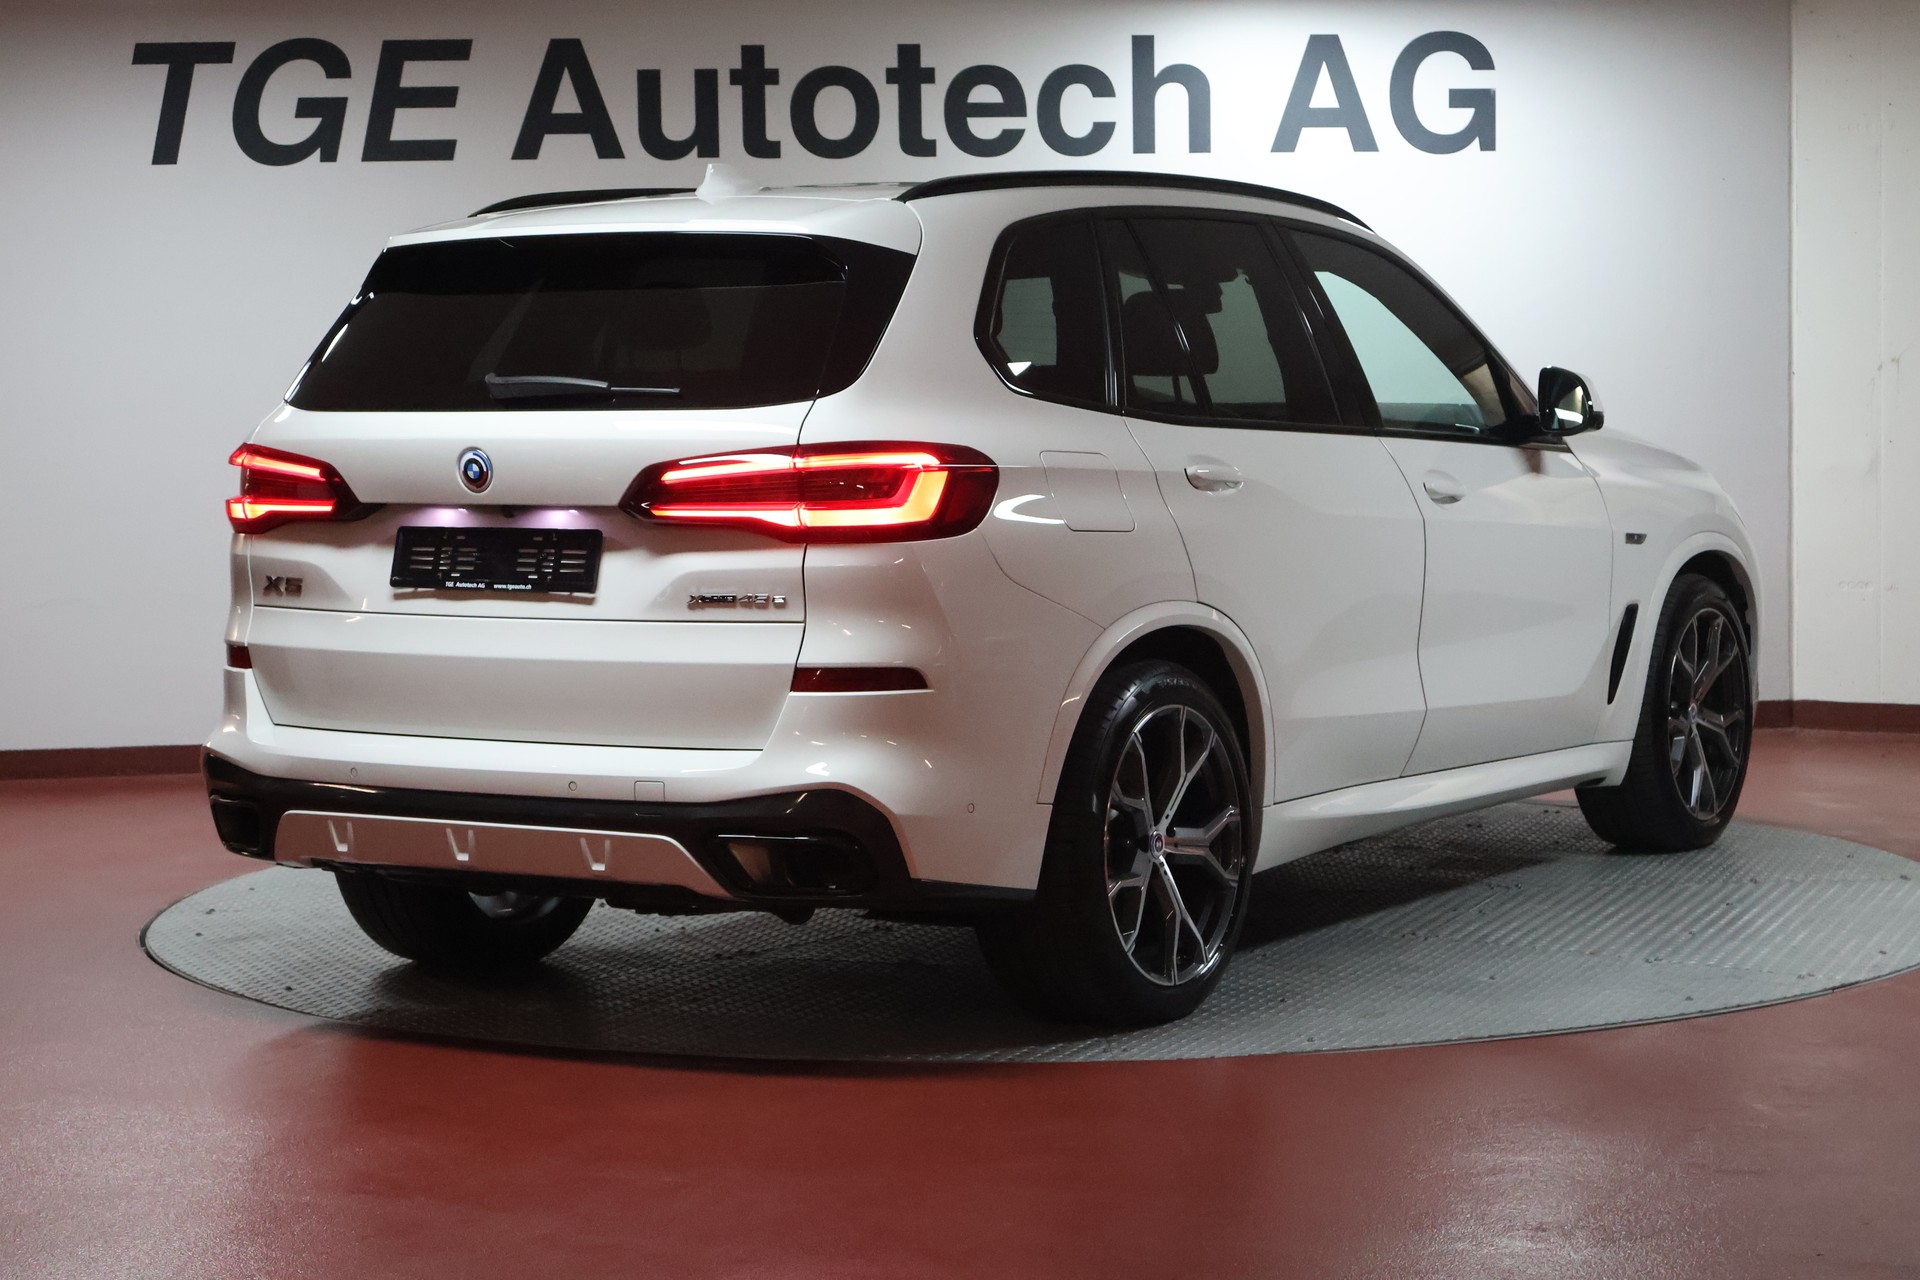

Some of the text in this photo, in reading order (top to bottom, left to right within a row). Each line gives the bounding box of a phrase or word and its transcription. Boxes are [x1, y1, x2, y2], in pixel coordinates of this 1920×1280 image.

[131, 30, 1497, 167] TGE Autotech AG
[263, 575, 304, 597] X5
[455, 581, 478, 589] Autotech
